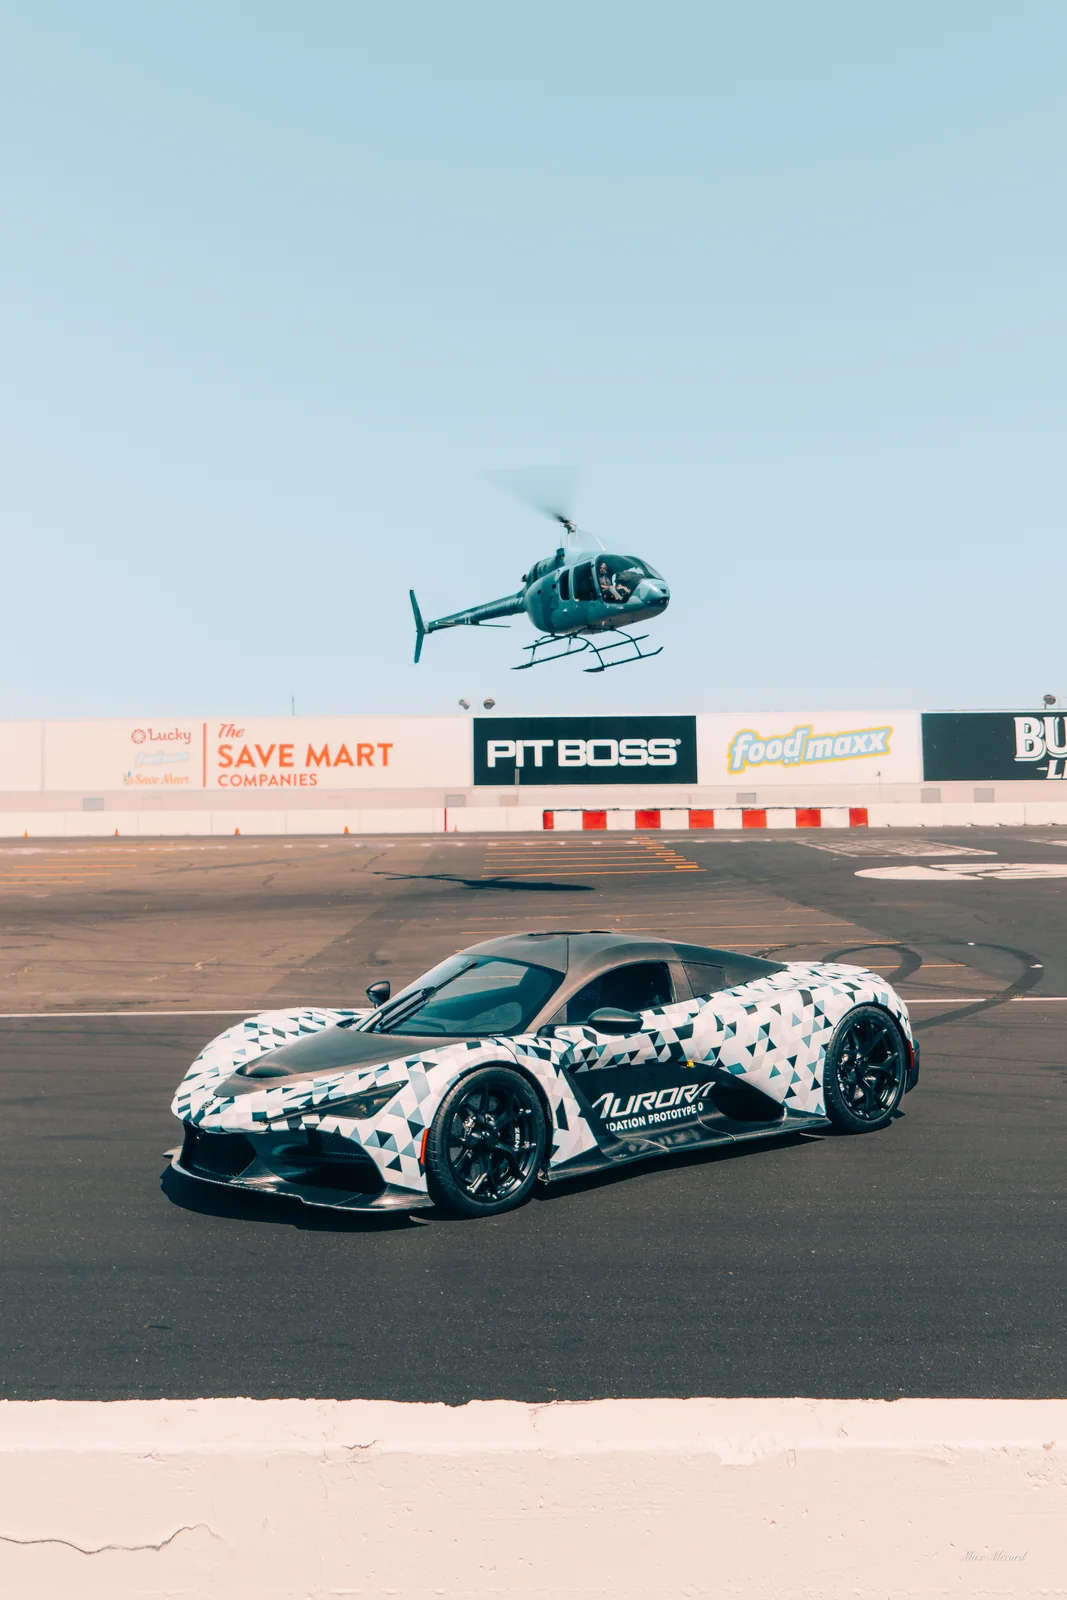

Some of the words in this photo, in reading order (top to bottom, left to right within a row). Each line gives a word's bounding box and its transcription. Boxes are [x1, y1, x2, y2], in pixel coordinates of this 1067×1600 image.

[147, 728, 192, 745] Lucky
[217, 723, 245, 739] The
[217, 744, 295, 768] SAVE
[305, 743, 393, 767] MART
[487, 740, 554, 767] PIT
[557, 738, 678, 767] BOSS
[217, 773, 318, 787] COMPANIES
[591, 1081, 716, 1119] AURORA
[647, 1104, 697, 1125] PROTOTYPE
